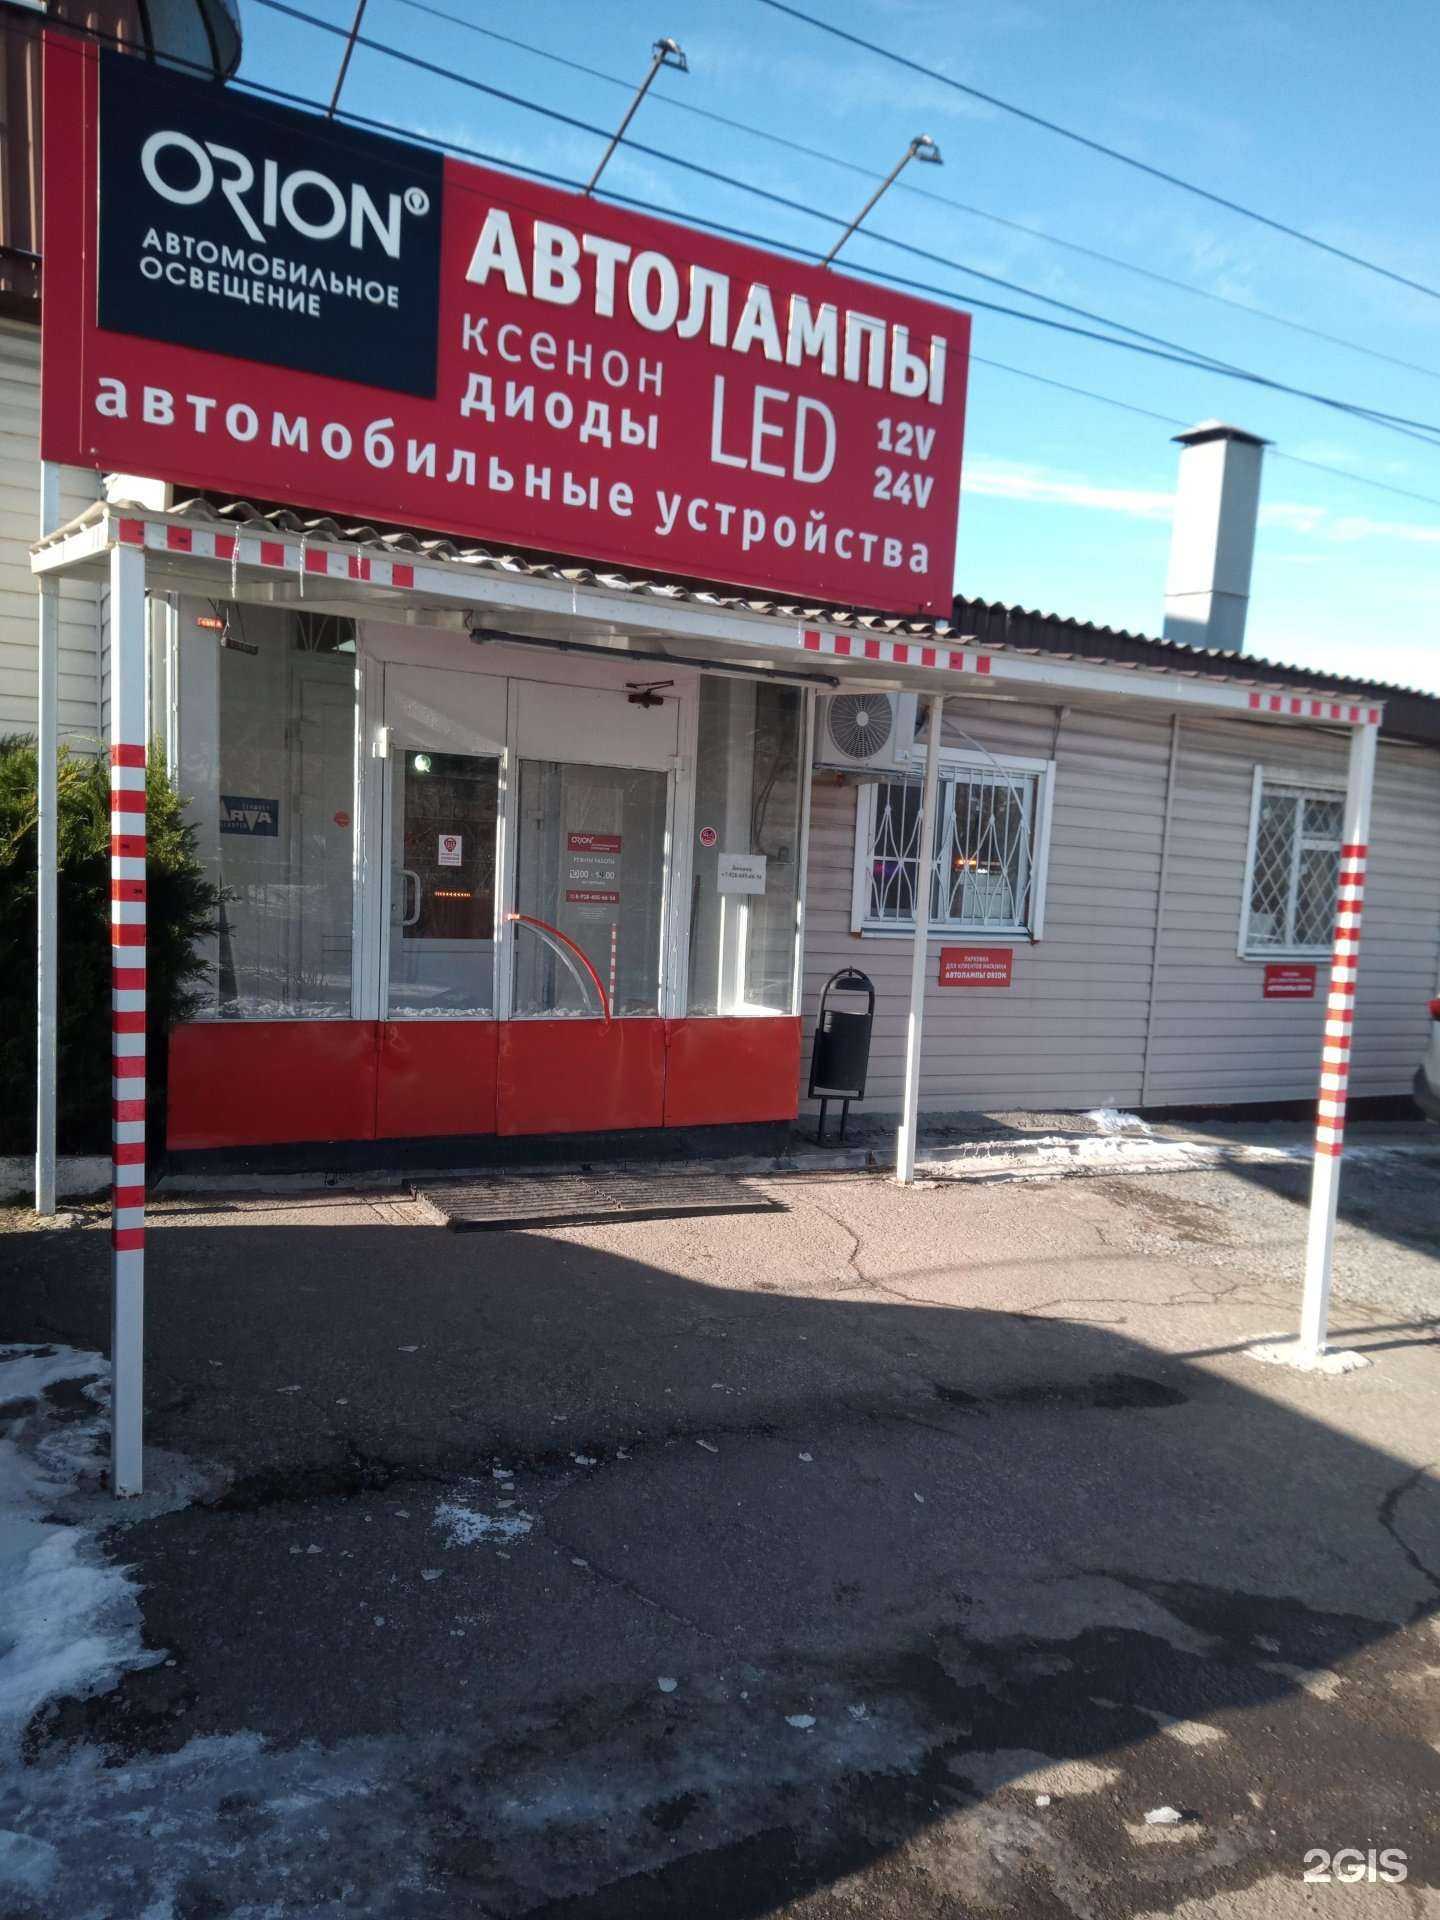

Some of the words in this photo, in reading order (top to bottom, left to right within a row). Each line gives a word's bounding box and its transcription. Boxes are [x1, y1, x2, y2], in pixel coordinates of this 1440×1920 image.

[141, 131, 401, 259] ORION
[140, 256, 322, 319] ОСВЕЩЕНИЕ
[142, 228, 400, 309] АВТОМОБИЛЬНОЕ
[465, 207, 947, 406] АВТОЛАМПЫ
[462, 313, 664, 397] ксенон
[460, 373, 659, 450] диоды
[710, 374, 838, 484] LED
[876, 417, 937, 462] 12V
[95, 376, 635, 518] автомобильные
[653, 490, 929, 575] устройства
[872, 465, 934, 509] 24V
